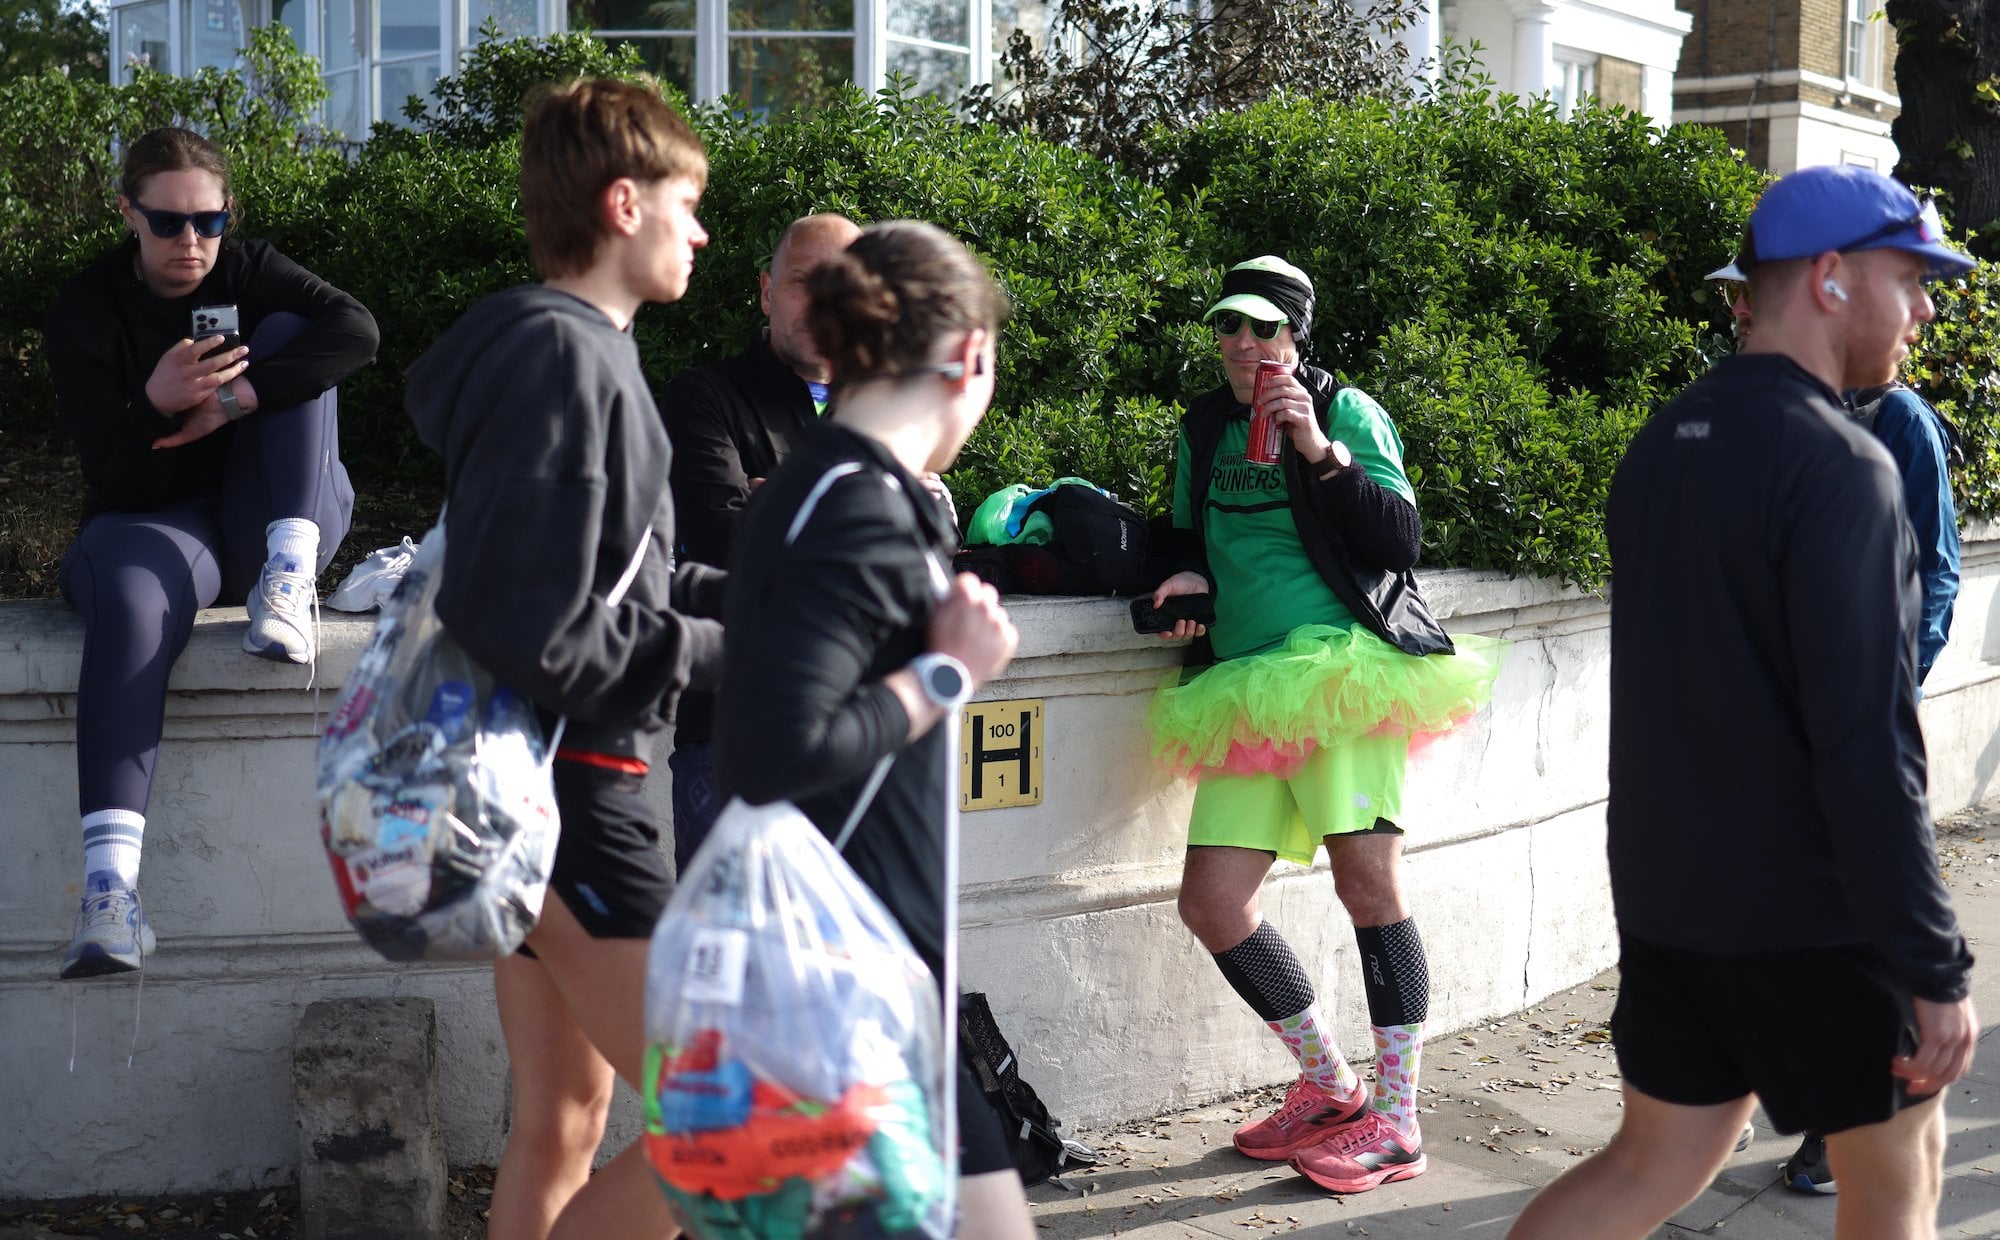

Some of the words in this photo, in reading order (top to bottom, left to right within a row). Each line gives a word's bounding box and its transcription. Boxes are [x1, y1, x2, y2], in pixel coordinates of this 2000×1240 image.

[1209, 466, 1281, 491] RUNNERS
[989, 723, 1015, 738] 100
[972, 711, 1031, 799] H
[998, 773, 1004, 787] 1
[1369, 954, 1385, 986] 2XU
